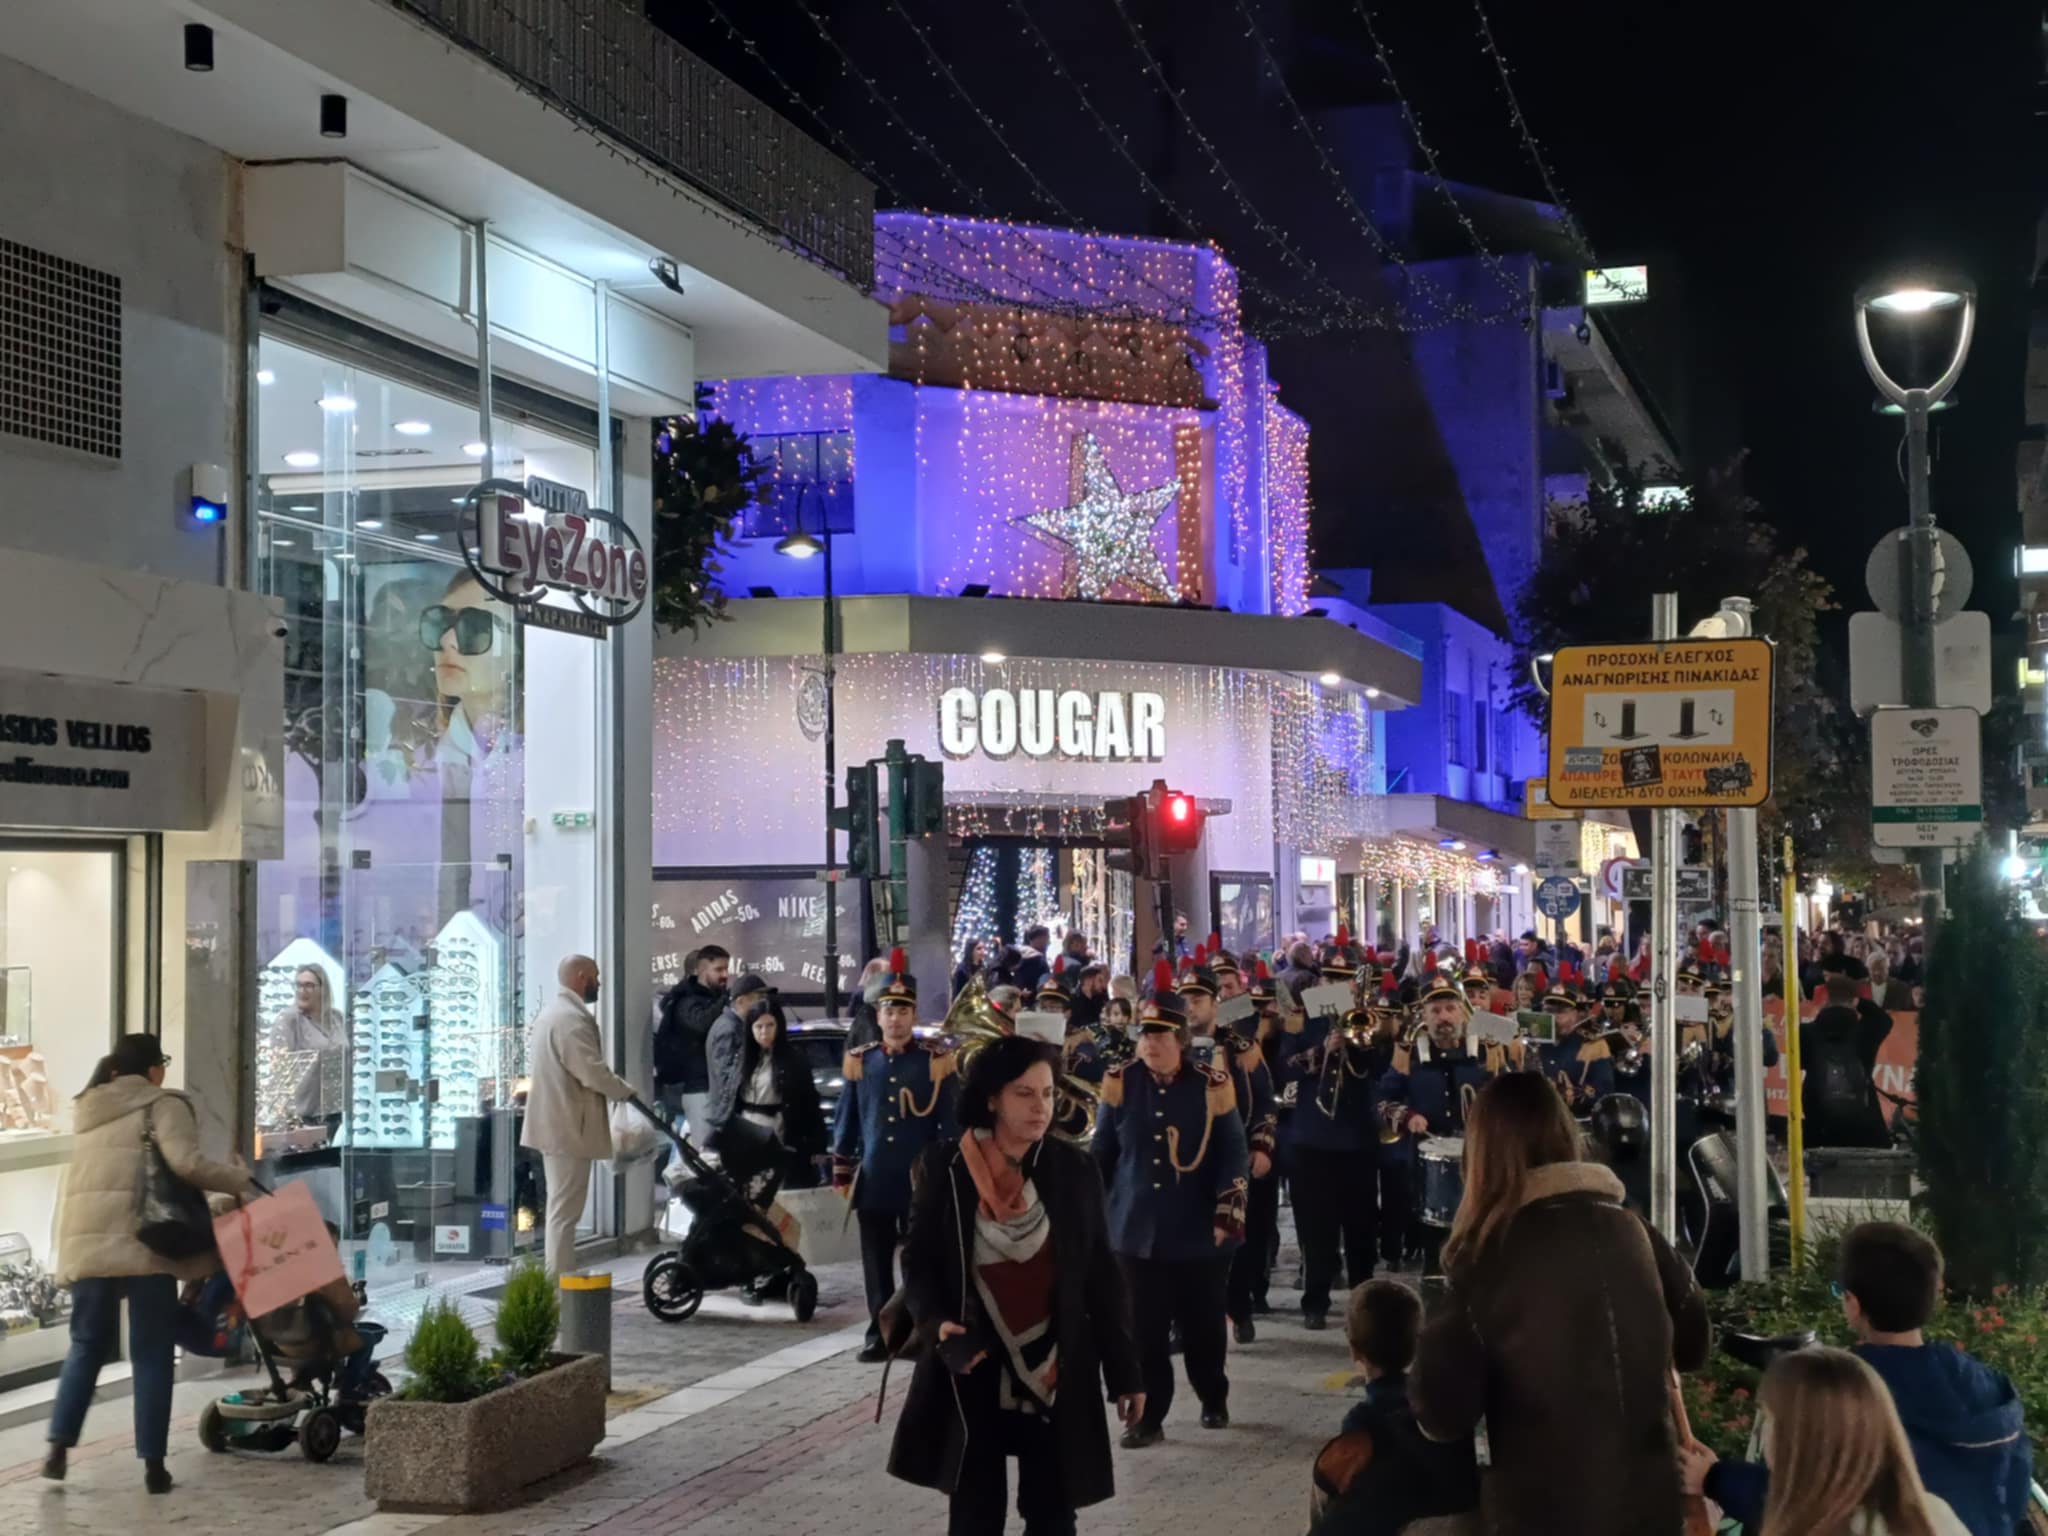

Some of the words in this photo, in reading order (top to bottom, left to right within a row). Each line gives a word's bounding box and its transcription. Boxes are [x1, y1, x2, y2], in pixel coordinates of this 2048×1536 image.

[528, 476, 588, 519] ΟΠΤΙΚΑ
[498, 494, 649, 602] EyeZone
[1587, 652, 1660, 667] ΠΡΟΣΟΧΗ
[1664, 649, 1735, 665] ΕΛΕΓΧΟΣ
[1562, 670, 1670, 686] ΑΝΑΓΝΩΡΙΣΗΣ
[1674, 667, 1760, 684] ΠΙΝΑΚΙΔΑΣ
[0, 714, 58, 747] SIOS
[938, 686, 1166, 759] COUGAR
[1663, 751, 1744, 764] ΚΟΛΩΝΑΚΙΑ
[1569, 785, 1634, 799] ΔΙΕΛΕΥΣΗ
[1638, 785, 1664, 798] ΔΥΟ
[690, 889, 739, 934] ADIDAS
[778, 896, 817, 918] NIKE
